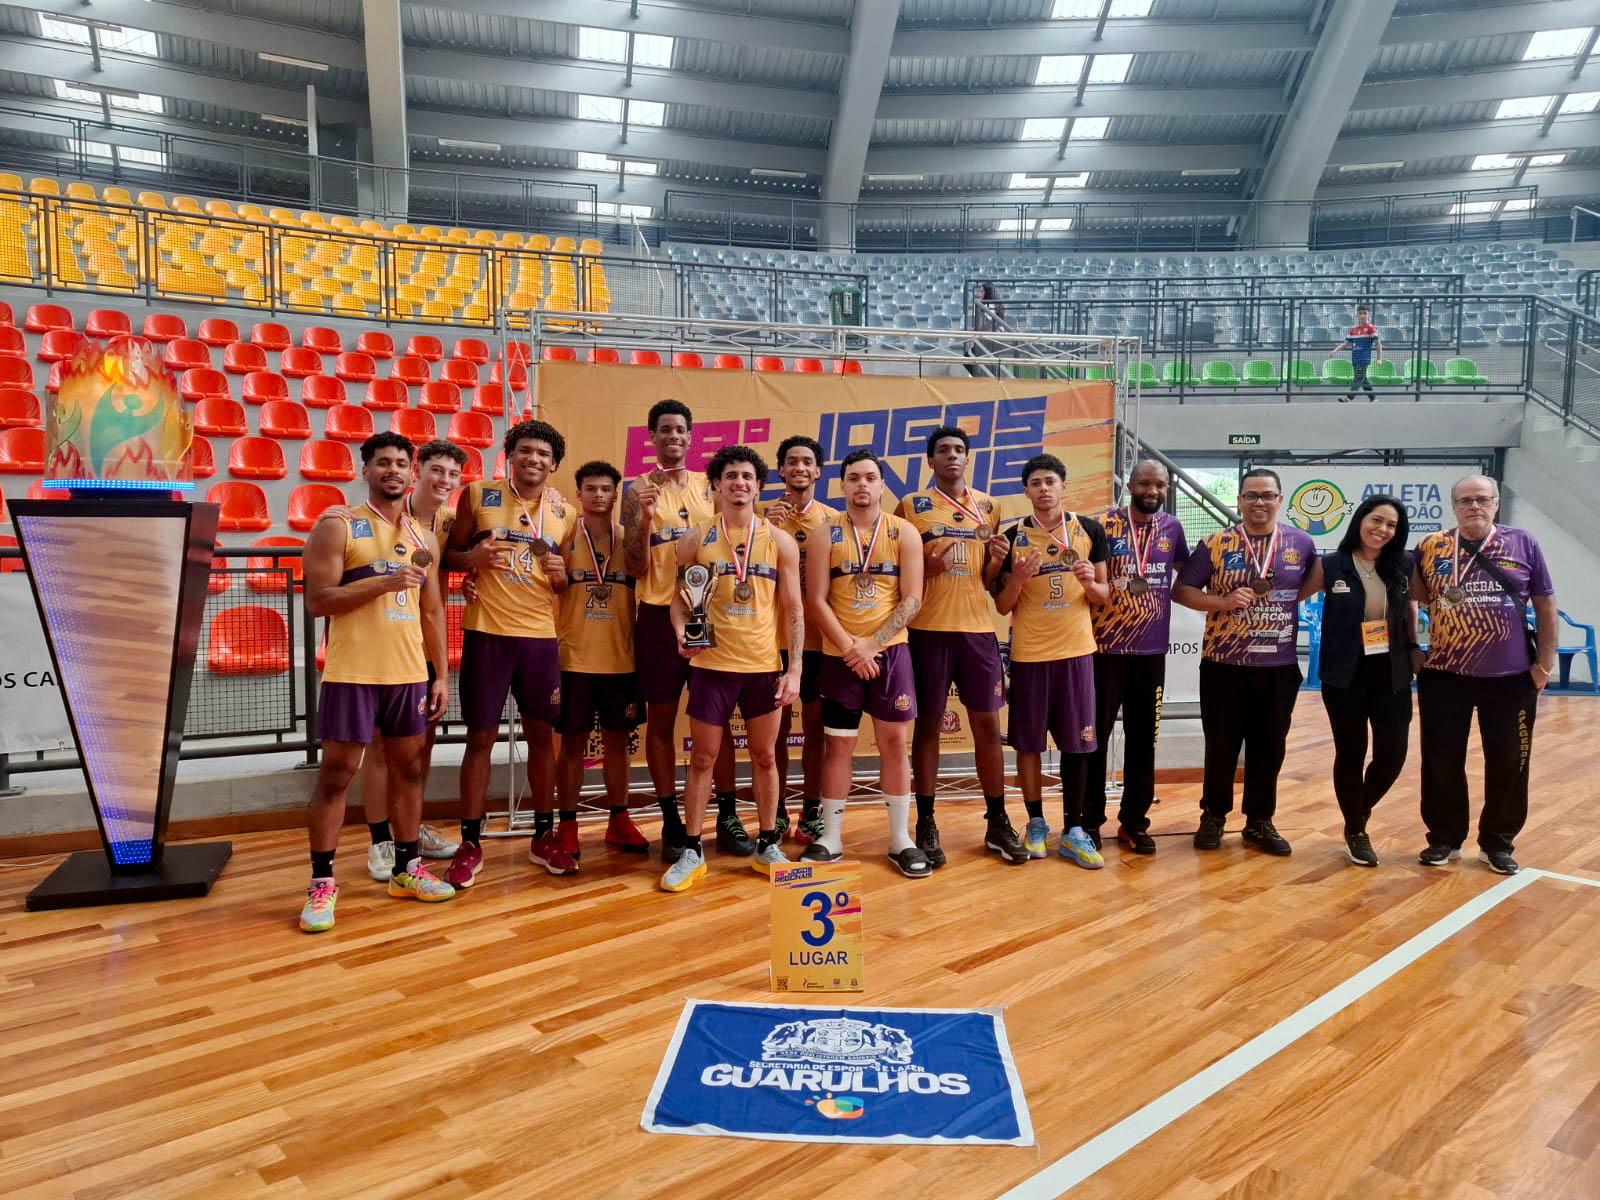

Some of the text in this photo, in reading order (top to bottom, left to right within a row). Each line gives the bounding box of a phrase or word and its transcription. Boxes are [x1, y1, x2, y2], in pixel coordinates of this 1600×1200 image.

[1232, 434, 1257, 444] SAÍDA
[1409, 524, 1439, 532] CAMPOS
[952, 541, 968, 565] 11
[1049, 575, 1064, 599] 5
[0, 672, 17, 689] S
[801, 891, 849, 947] 3º
[789, 951, 849, 966] LUGAR
[749, 1060, 811, 1070] SECRETARIA
[700, 1063, 971, 1096] GUARULHOS
